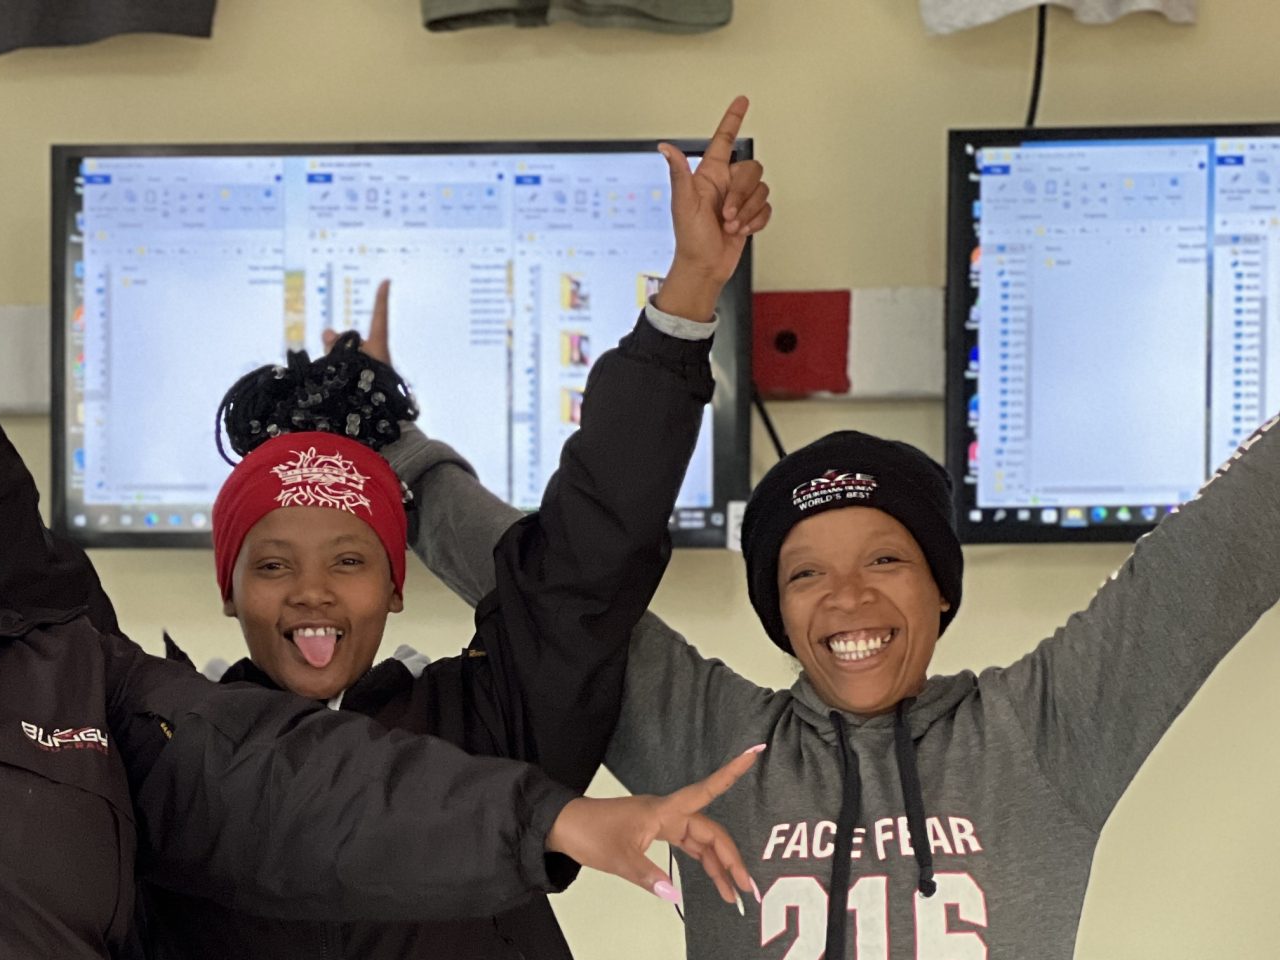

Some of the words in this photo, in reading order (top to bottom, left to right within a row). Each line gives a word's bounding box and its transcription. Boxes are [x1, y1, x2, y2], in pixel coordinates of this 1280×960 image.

[799, 493, 842, 511] WORLD'S
[846, 491, 870, 499] BEST
[21, 721, 108, 747] BUNGY
